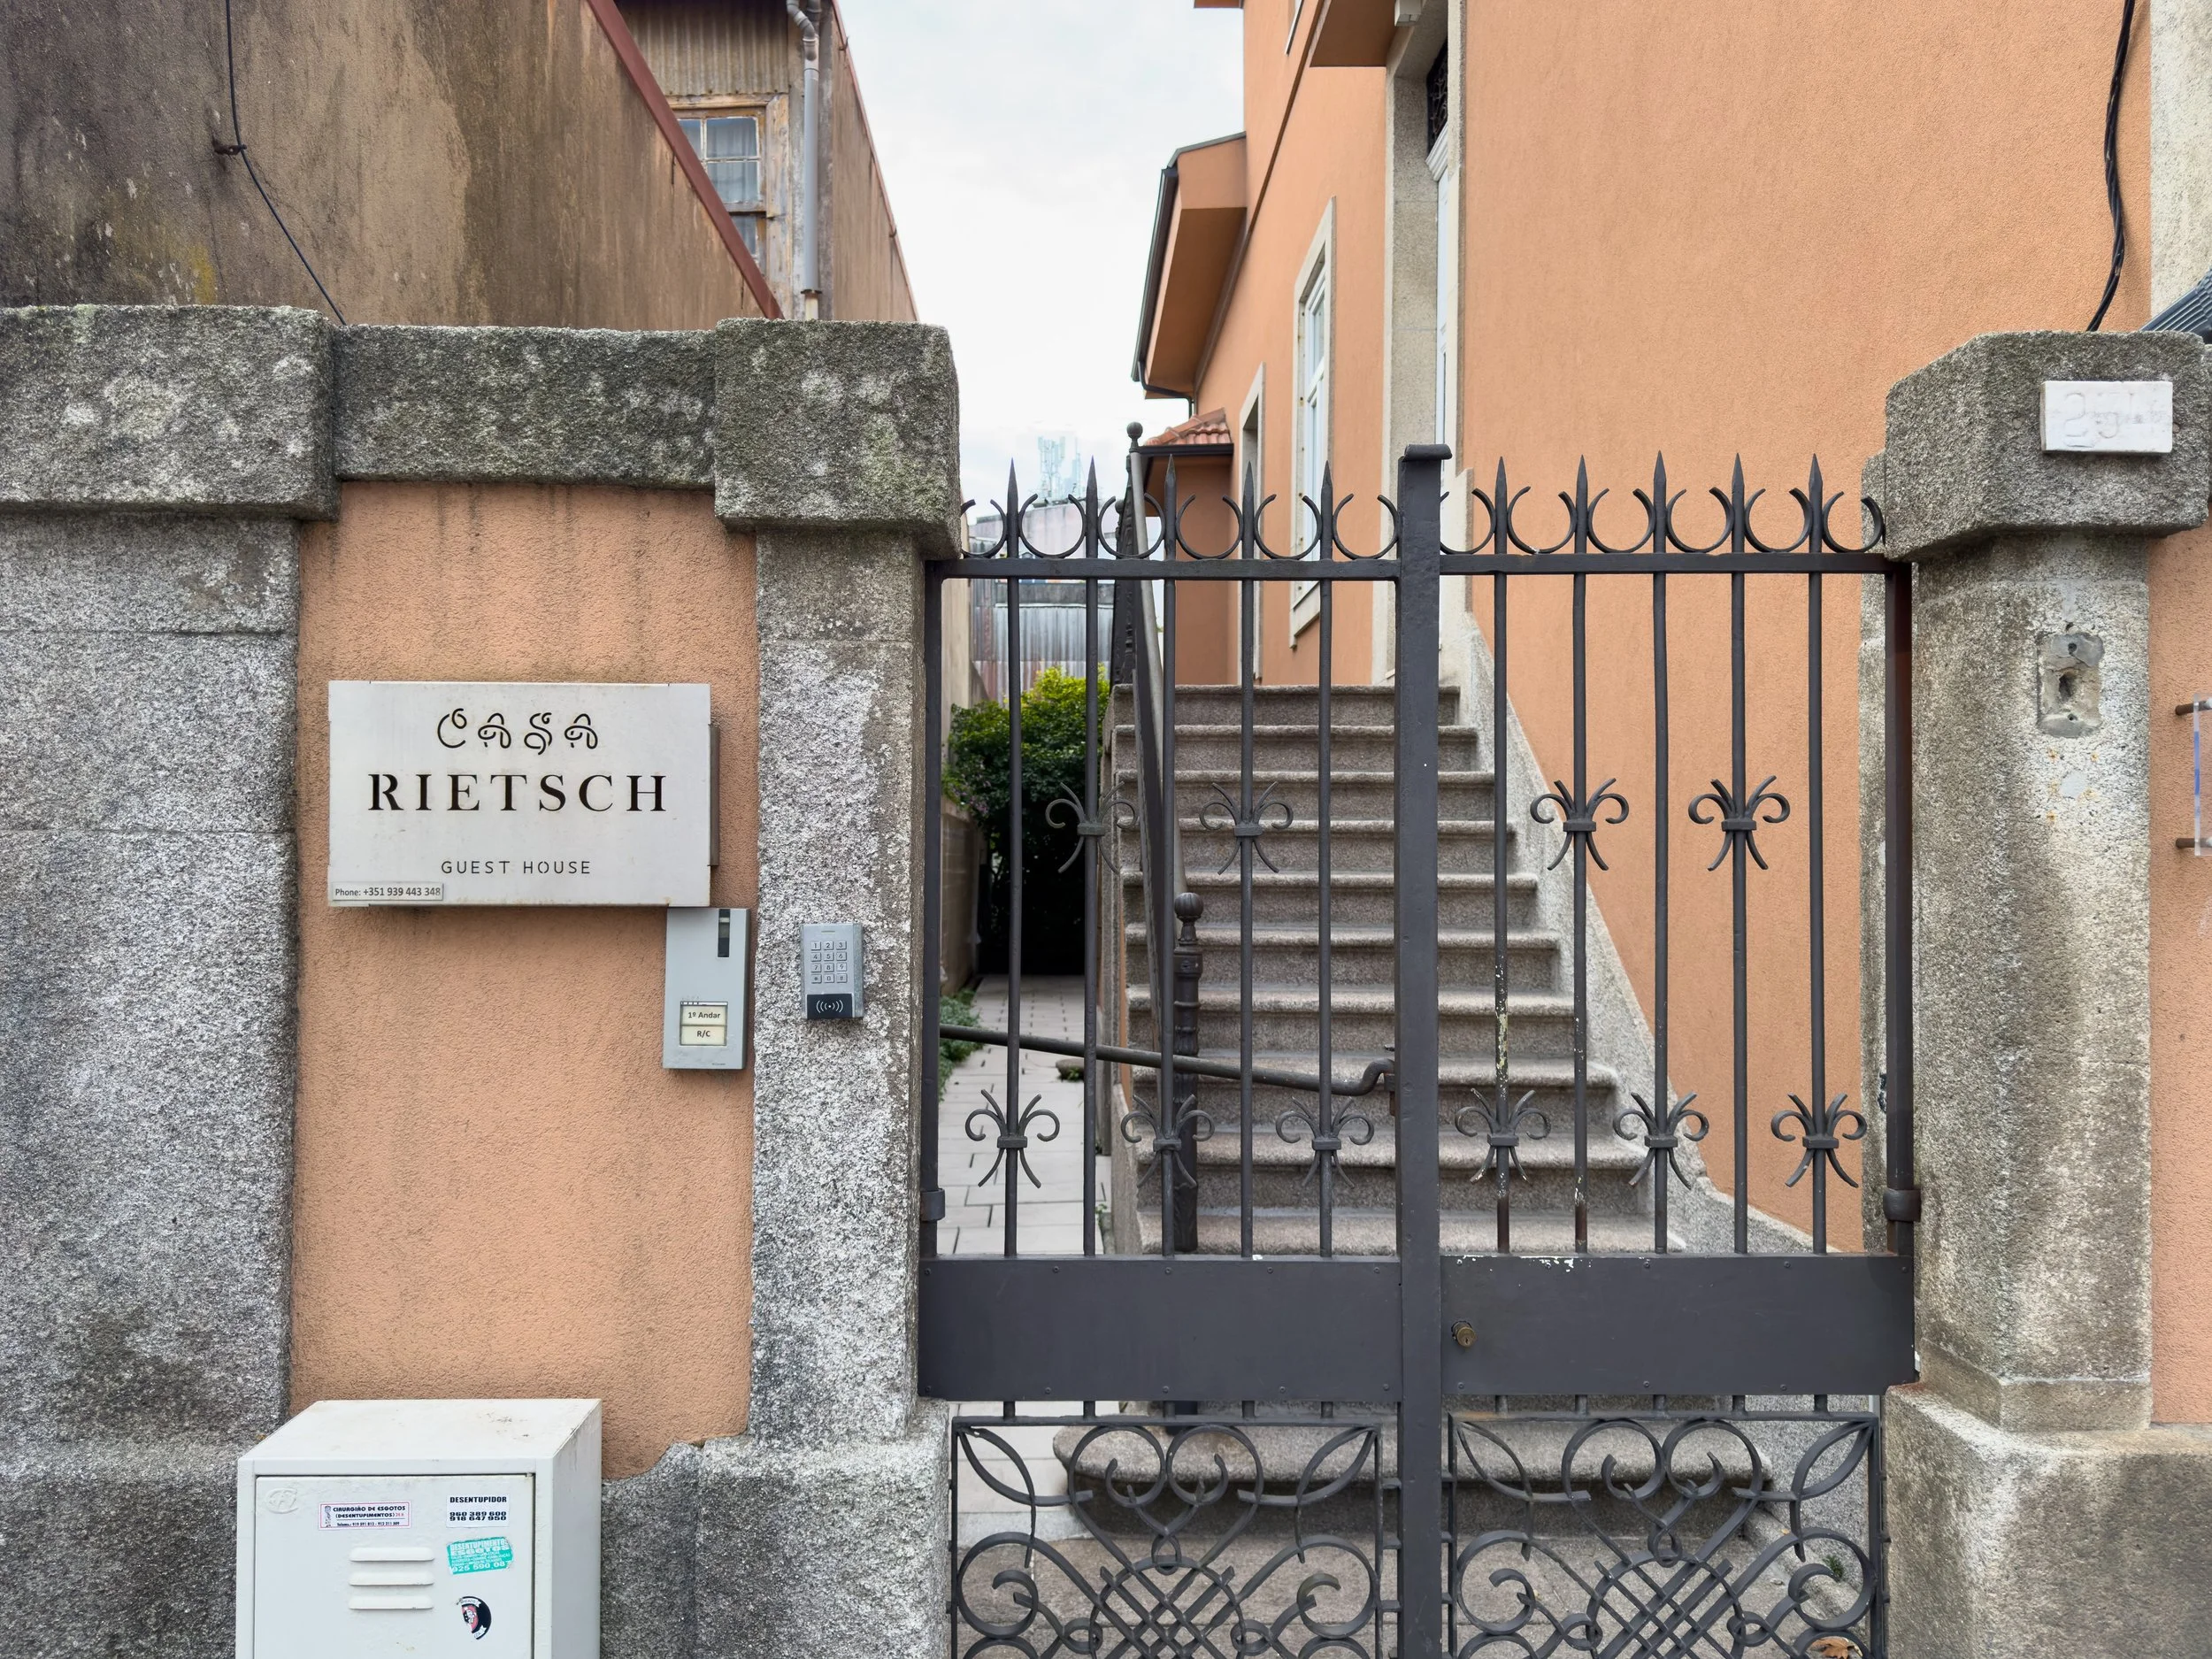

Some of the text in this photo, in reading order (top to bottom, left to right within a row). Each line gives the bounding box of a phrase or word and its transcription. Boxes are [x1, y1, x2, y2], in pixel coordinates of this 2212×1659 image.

[436, 708, 599, 756] CASA
[368, 773, 667, 812] RIETSCH
[441, 860, 591, 874] GUEST HOUSE
[334, 887, 441, 896] Phone: +351 939 443 348
